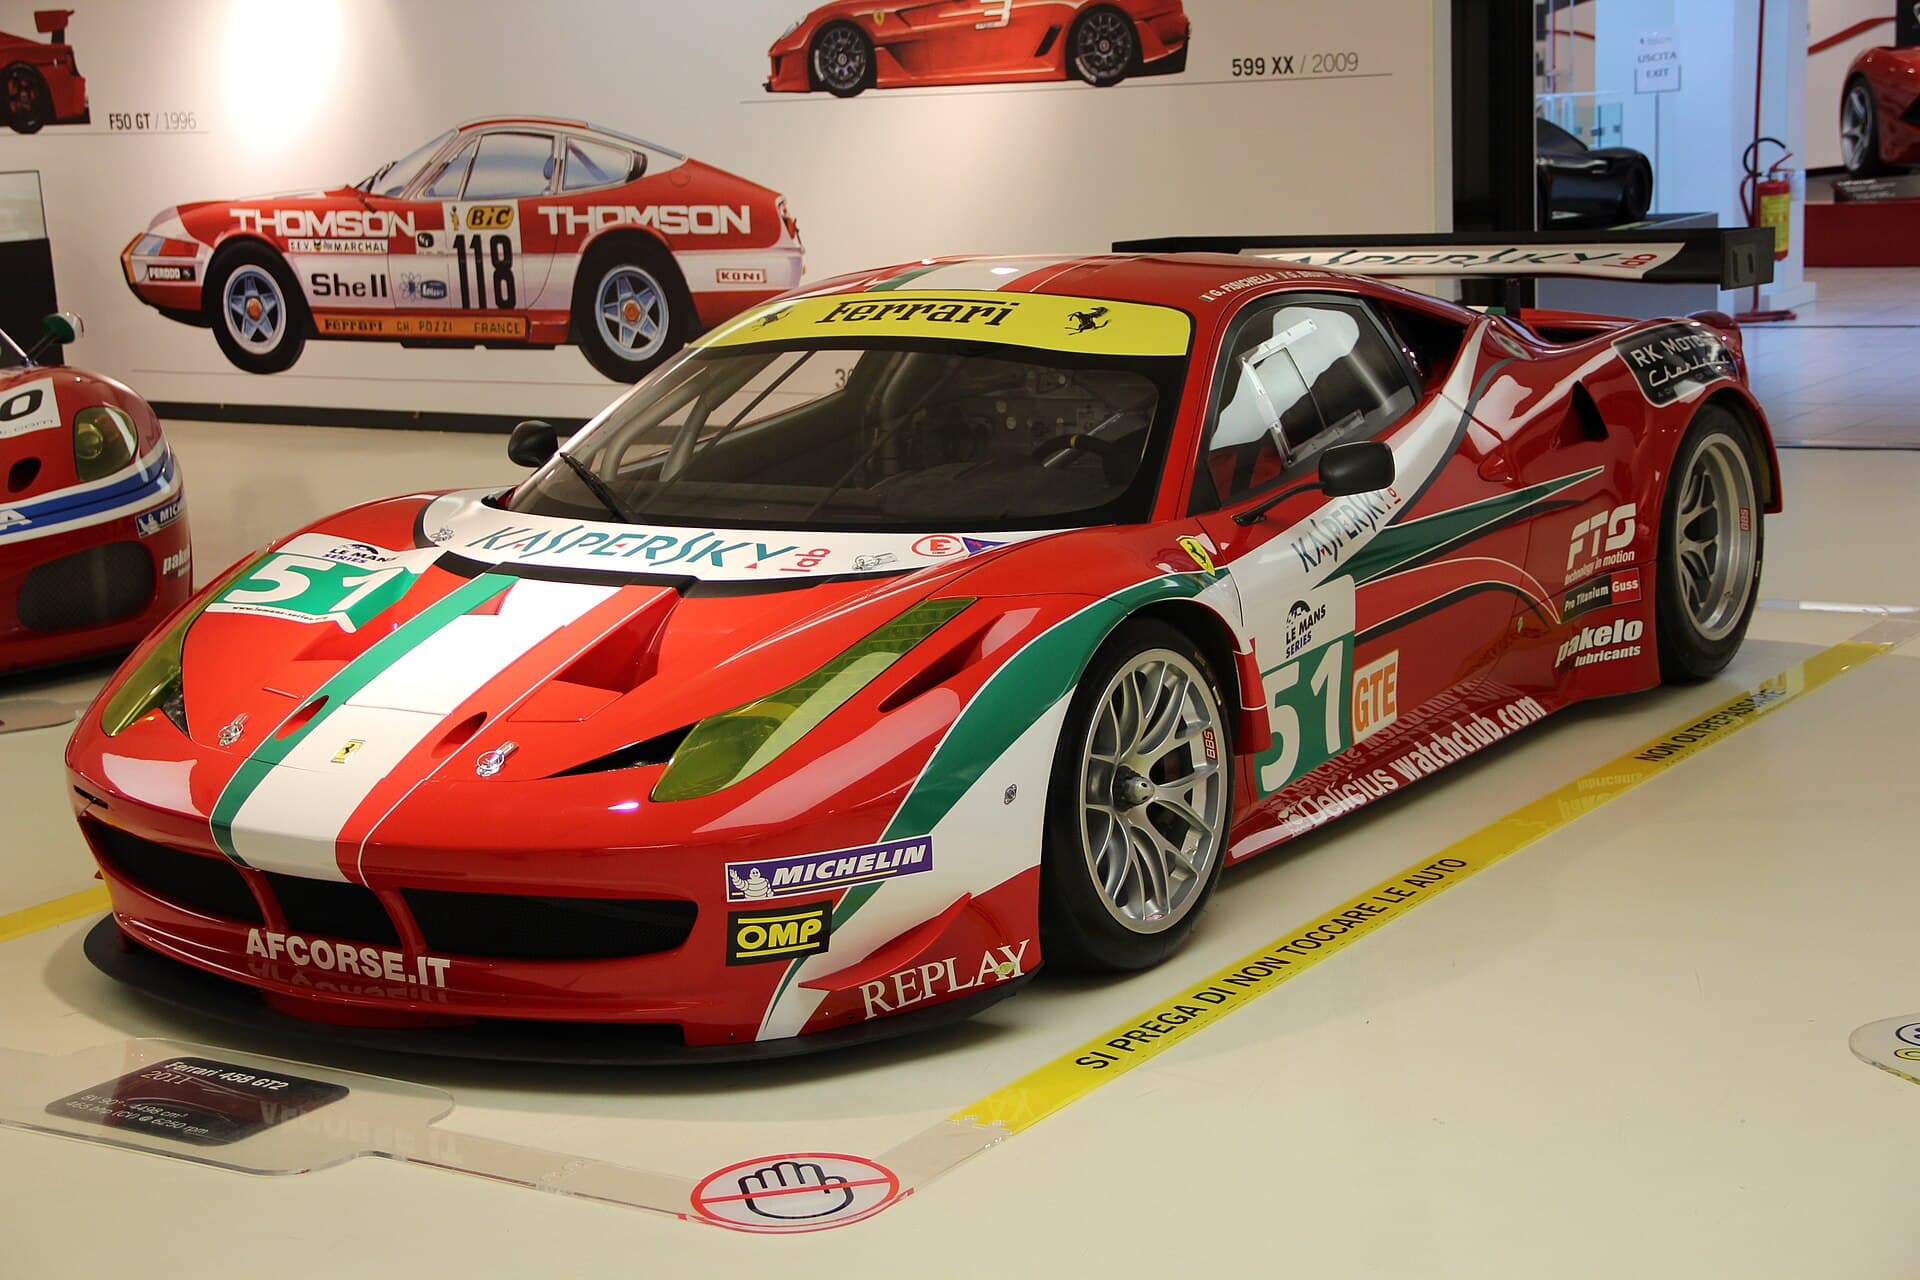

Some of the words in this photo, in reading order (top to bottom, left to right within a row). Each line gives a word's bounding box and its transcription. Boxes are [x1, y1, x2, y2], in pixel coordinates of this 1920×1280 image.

[1232, 57, 1265, 76] 599
[1271, 55, 1294, 75] XX
[1312, 51, 1359, 73] 2009
[109, 113, 132, 130] F50
[135, 113, 150, 130] GT
[164, 111, 198, 130] 1996
[229, 208, 416, 238] THOMSON
[538, 204, 751, 236] THOMSON
[333, 241, 386, 252] MARCHAL
[1280, 247, 1622, 269] ASPERSKY
[311, 273, 387, 297] Shell
[453, 234, 517, 310] 118
[721, 272, 762, 281] KONI
[1220, 272, 1279, 293] FISICHELLA
[324, 318, 383, 332] Ferrari
[474, 321, 521, 334] FRANCE
[815, 298, 1021, 326] Ferrari
[1630, 343, 1664, 367] RK
[465, 524, 800, 570] KASPERSKY
[1566, 502, 1637, 571] FTS
[322, 553, 367, 564] SERIES
[329, 548, 352, 556] LE
[1564, 560, 1594, 586] technology
[1594, 558, 1602, 570] in
[1603, 550, 1635, 567] motion
[223, 554, 404, 613] 51
[1564, 599, 1576, 612] Pro
[1576, 585, 1609, 603] Titanium
[1612, 579, 1639, 593] Guss
[1286, 627, 1297, 645] LE
[1298, 604, 1326, 635] MANS
[1285, 630, 1312, 659] SERIES
[1555, 618, 1643, 668] pakelo
[1575, 645, 1641, 668] lubricants
[1354, 662, 1397, 732] GTE
[1261, 640, 1344, 793] 51
[1204, 730, 1216, 759] BBS
[1388, 695, 1547, 783] watchclub.com
[1635, 743, 1680, 762] NON
[772, 844, 926, 886] MICHELIN
[736, 919, 822, 950] OMP
[245, 927, 451, 988] AFCORSE.IT
[1075, 1051, 1120, 1069] SI
[1106, 1003, 1207, 1052] PREGA
[1192, 985, 1236, 1005] DI
[1222, 956, 1292, 988] NON
[1276, 902, 1388, 955] TOCCARE
[1373, 886, 1417, 904] LE
[1405, 857, 1469, 891] AUTO
[858, 939, 1030, 1020] REPLAY
[140, 1070, 192, 1086] 2011
[164, 1061, 222, 1077] Ferrari
[218, 1072, 255, 1083] 458
[252, 1078, 289, 1091] GT2
[151, 1118, 186, 1129] 6250
[183, 1125, 209, 1135] rpm
